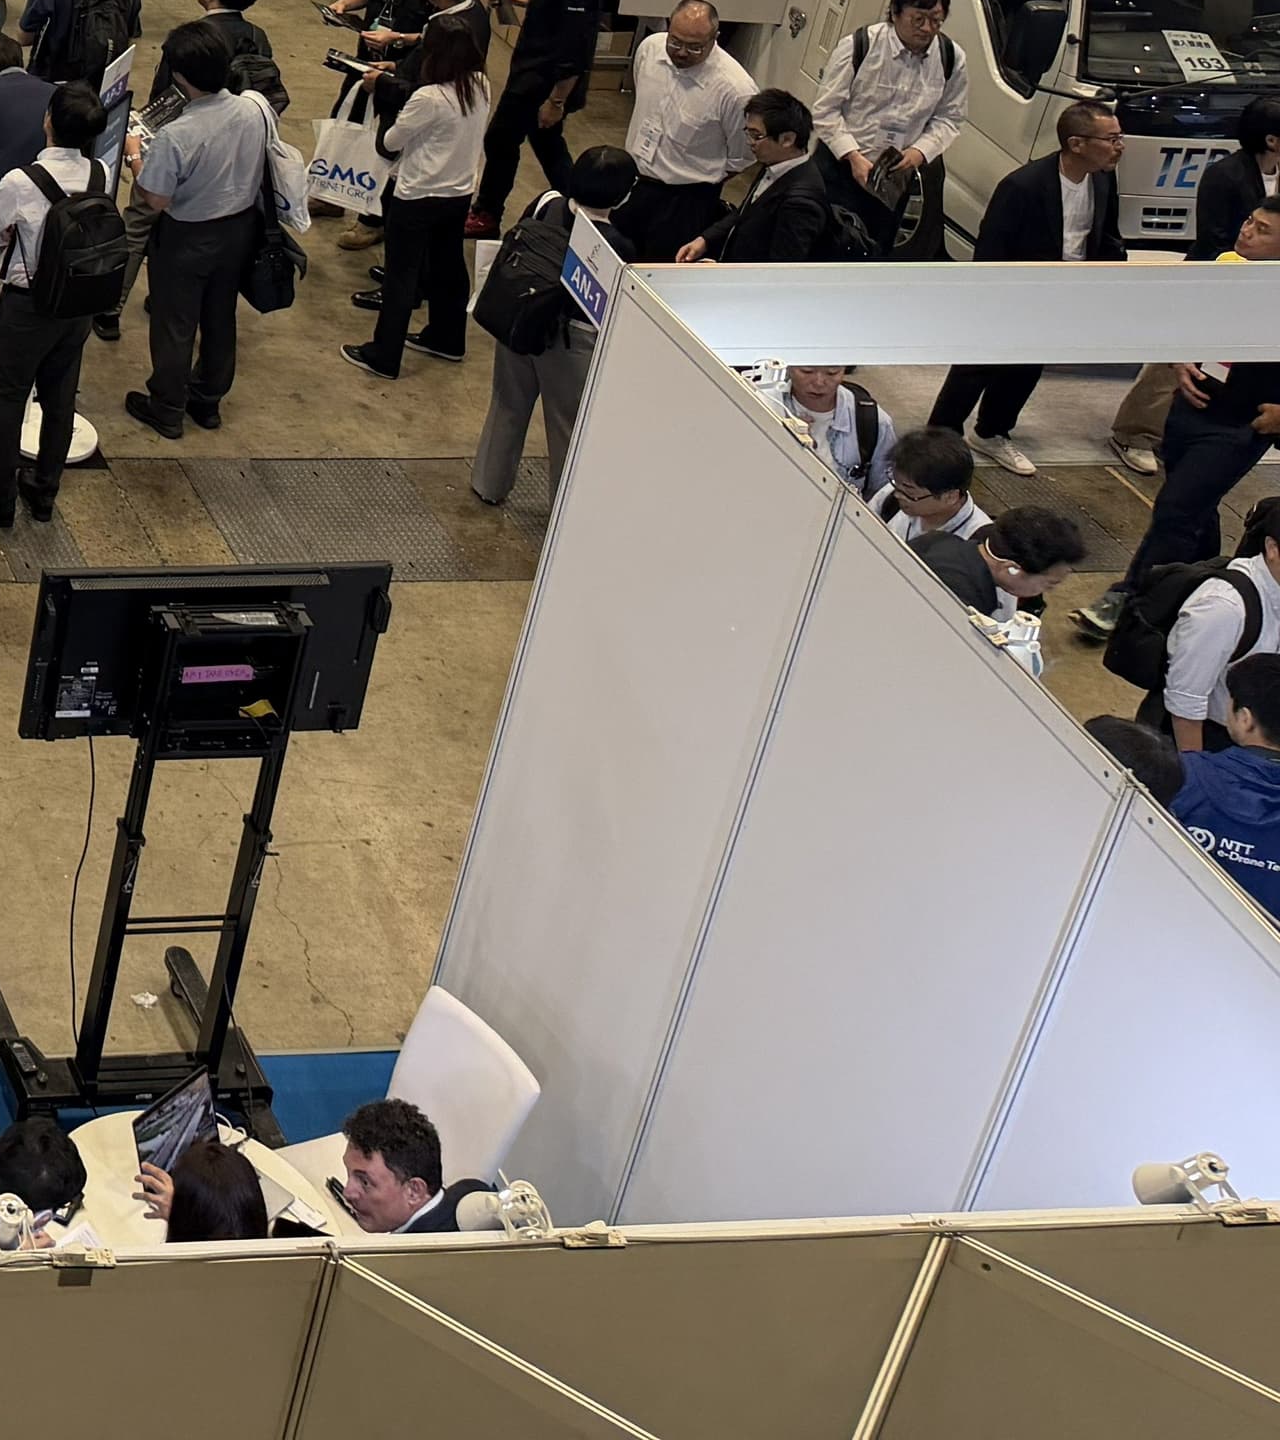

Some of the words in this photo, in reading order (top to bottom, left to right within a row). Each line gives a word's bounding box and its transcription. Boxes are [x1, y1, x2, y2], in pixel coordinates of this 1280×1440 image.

[1183, 56, 1226, 69] 163
[308, 158, 377, 190] GMO
[570, 264, 603, 314] AN-1
[1219, 838, 1255, 856] NTT
[1216, 850, 1265, 868] e-Drone
